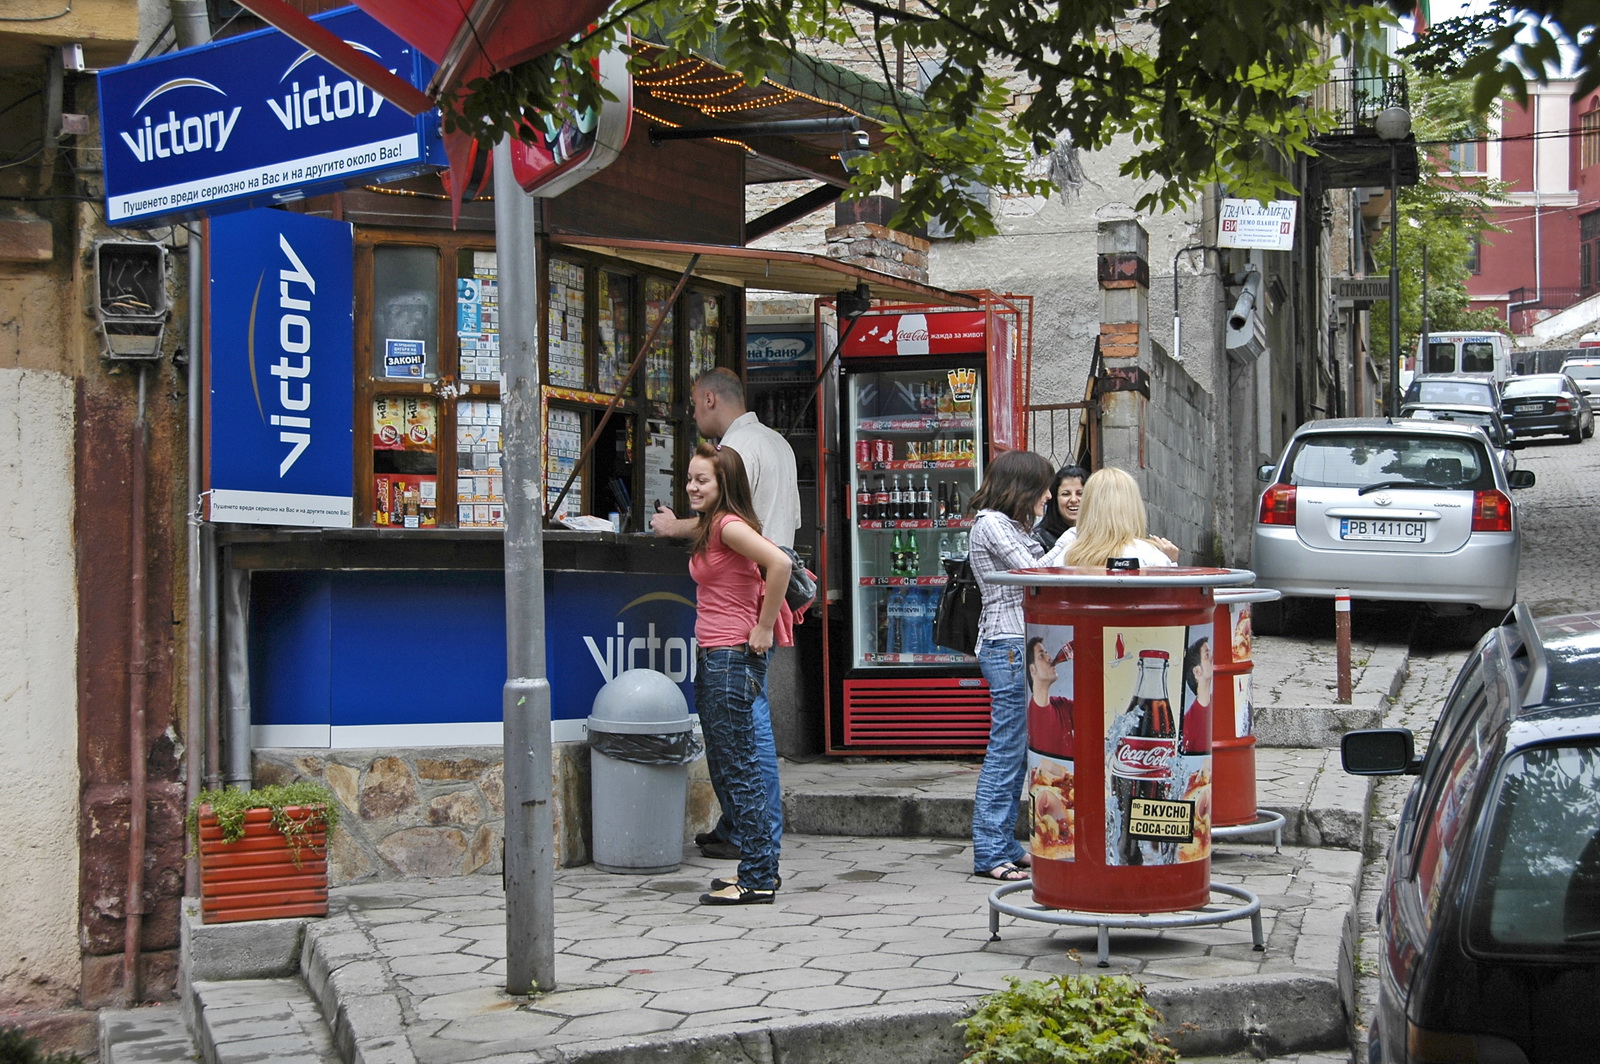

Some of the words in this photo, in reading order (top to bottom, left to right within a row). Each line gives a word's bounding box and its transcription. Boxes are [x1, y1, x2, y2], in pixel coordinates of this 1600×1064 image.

[120, 106, 242, 162] victory
[123, 195, 168, 215] Пушенето
[170, 189, 199, 204] вреди
[201, 180, 246, 199] сериозно
[248, 177, 260, 188] на
[262, 169, 280, 186] Вас
[282, 171, 289, 180] и
[291, 166, 303, 180] на
[305, 159, 345, 178] другите
[346, 151, 377, 167] около
[379, 143, 402, 161] Вас!
[1340, 283, 1390, 297] СТОМАТОЛО
[896, 329, 929, 342] Coca-Cola
[270, 232, 316, 479] victory
[765, 346, 798, 358] Баня
[388, 355, 421, 366] ЗАКОН!
[213, 502, 238, 510] Пушенето
[1350, 521, 1368, 535] PB
[1371, 522, 1402, 537] 1411
[1404, 523, 1424, 536] CH
[1118, 744, 1172, 768] Coca-Cola
[1135, 822, 1189, 836] COCA-COLA!
